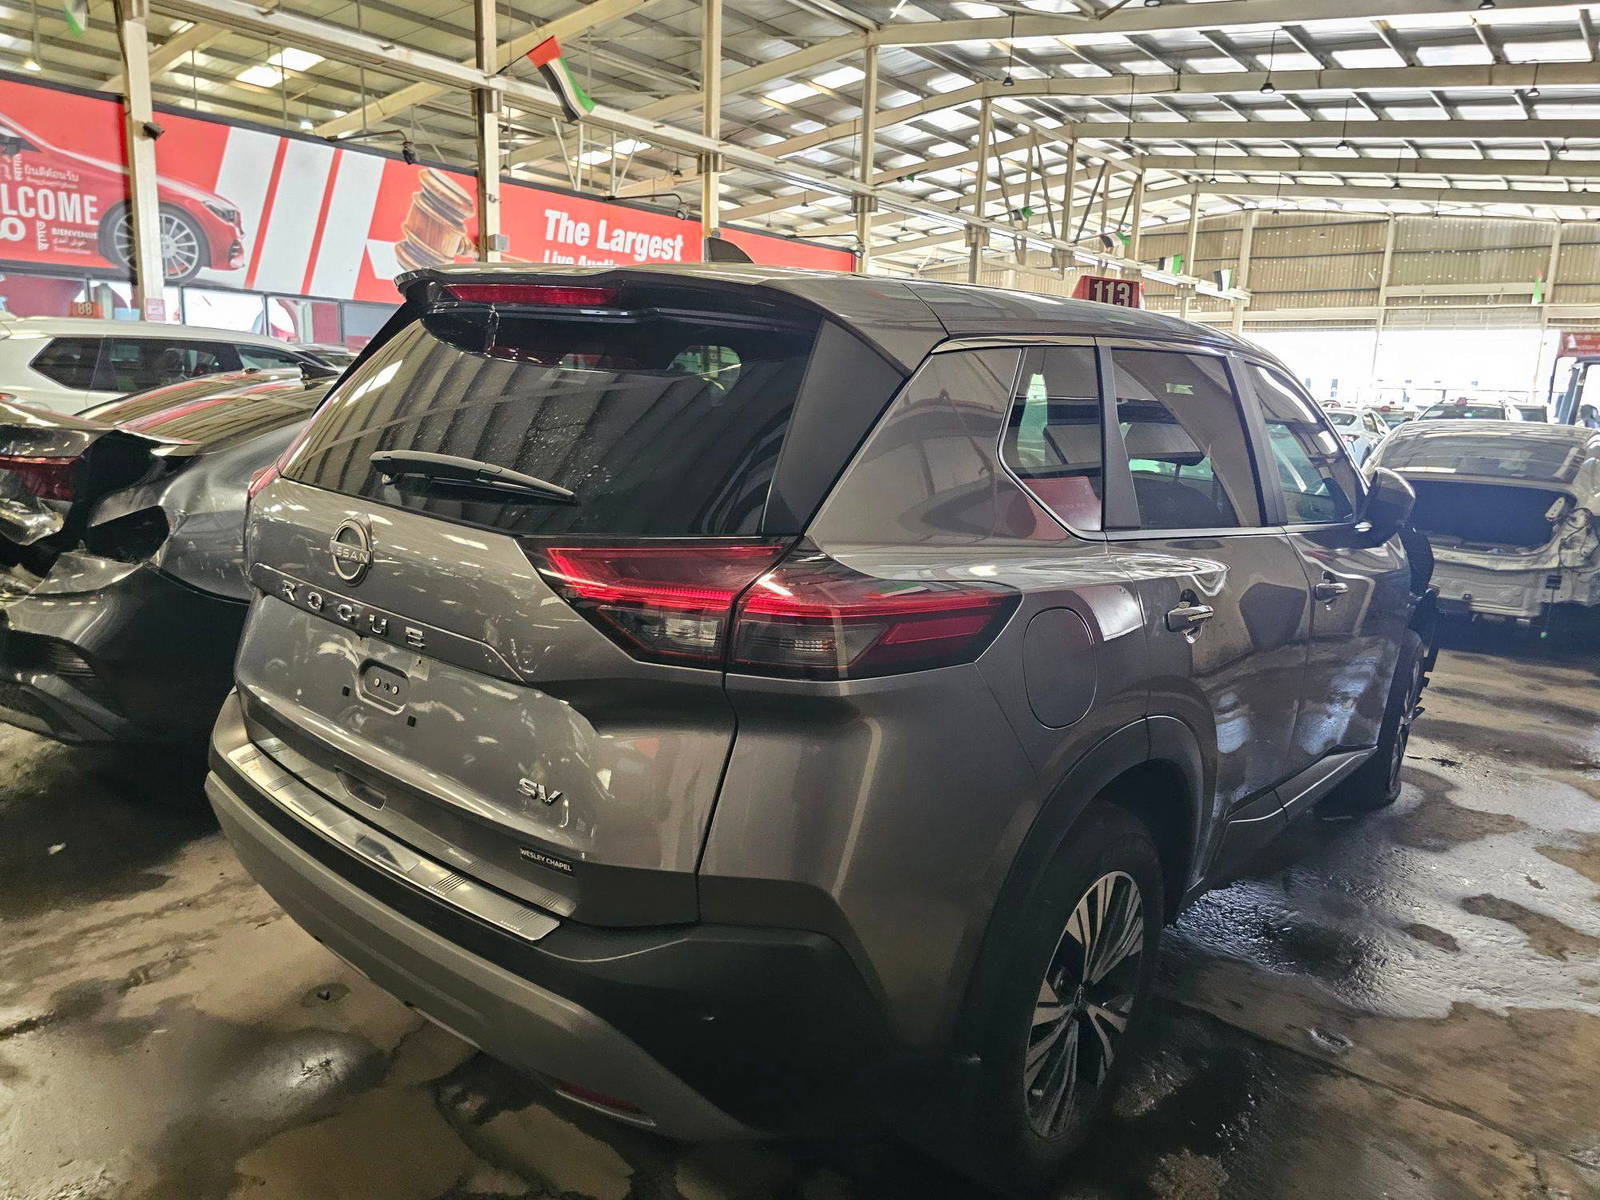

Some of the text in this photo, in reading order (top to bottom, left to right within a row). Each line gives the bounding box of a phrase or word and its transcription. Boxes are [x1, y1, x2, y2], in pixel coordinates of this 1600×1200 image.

[545, 209, 684, 262] The Largest
[1094, 280, 1130, 307] 113
[281, 579, 426, 648] ROGUE
[518, 778, 562, 805] SV
[520, 847, 573, 872] WESLEY CHAPEL
